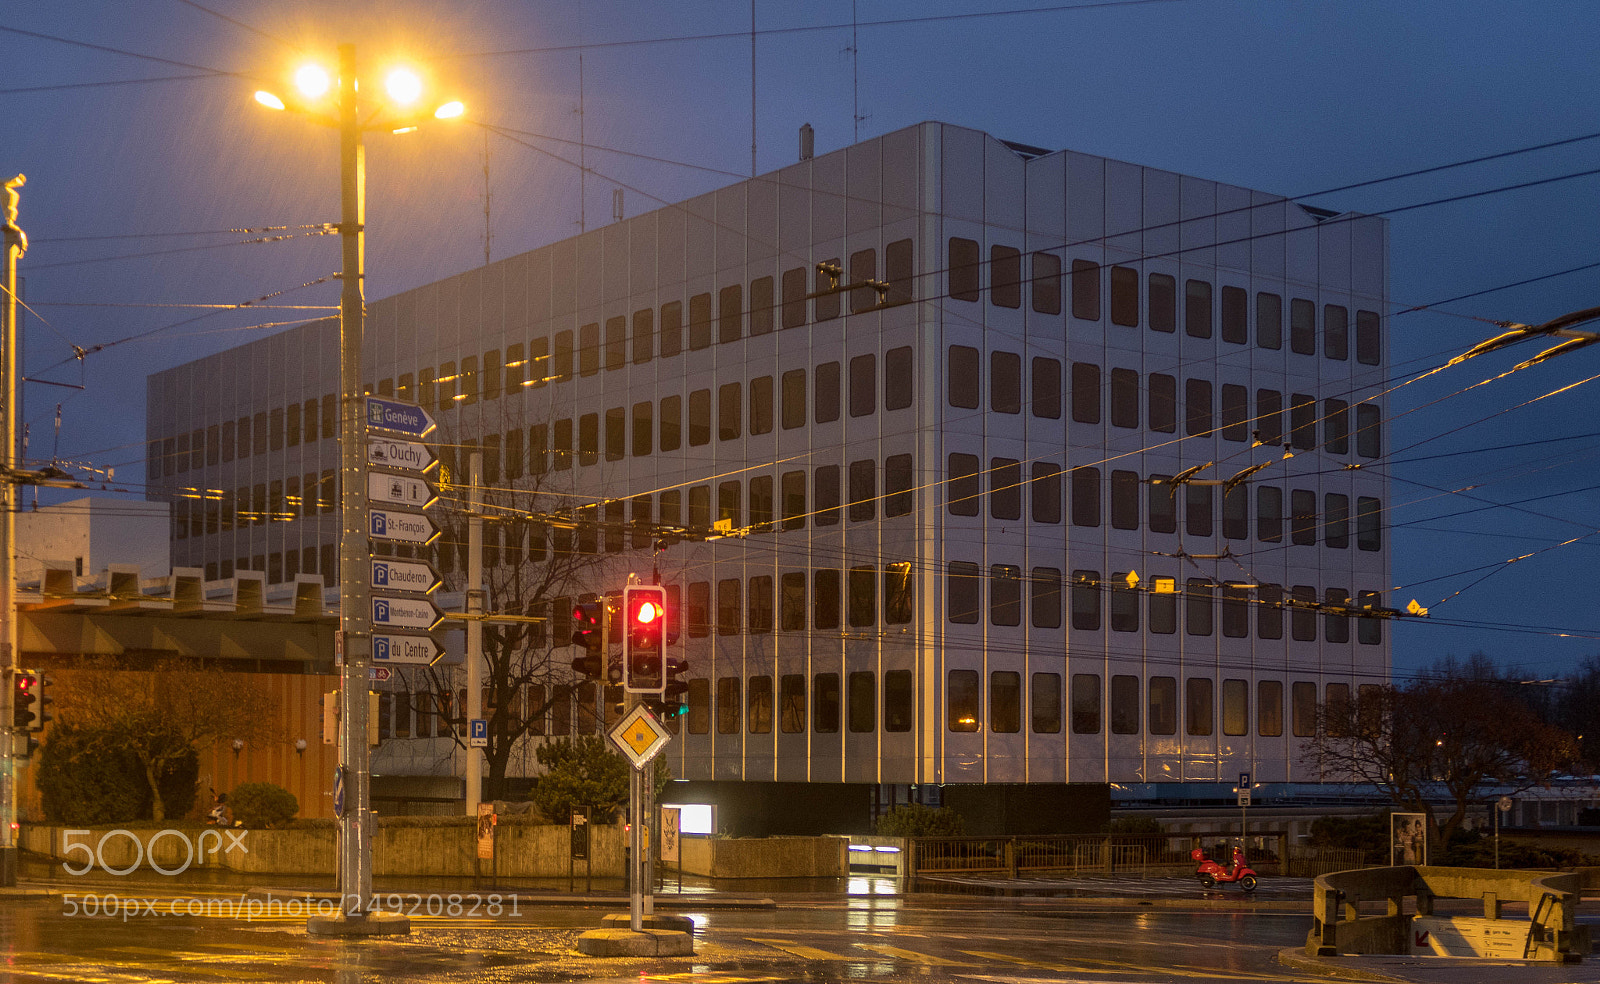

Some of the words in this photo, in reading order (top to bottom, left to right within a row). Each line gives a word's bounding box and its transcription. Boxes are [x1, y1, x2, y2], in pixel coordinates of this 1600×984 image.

[385, 408, 418, 426] Genève
[389, 445, 421, 466] Ouchy
[389, 568, 427, 583] Chauderon
[391, 641, 401, 657] du
[404, 641, 429, 658] Centre
[475, 722, 483, 737] P
[1241, 775, 1248, 787] P
